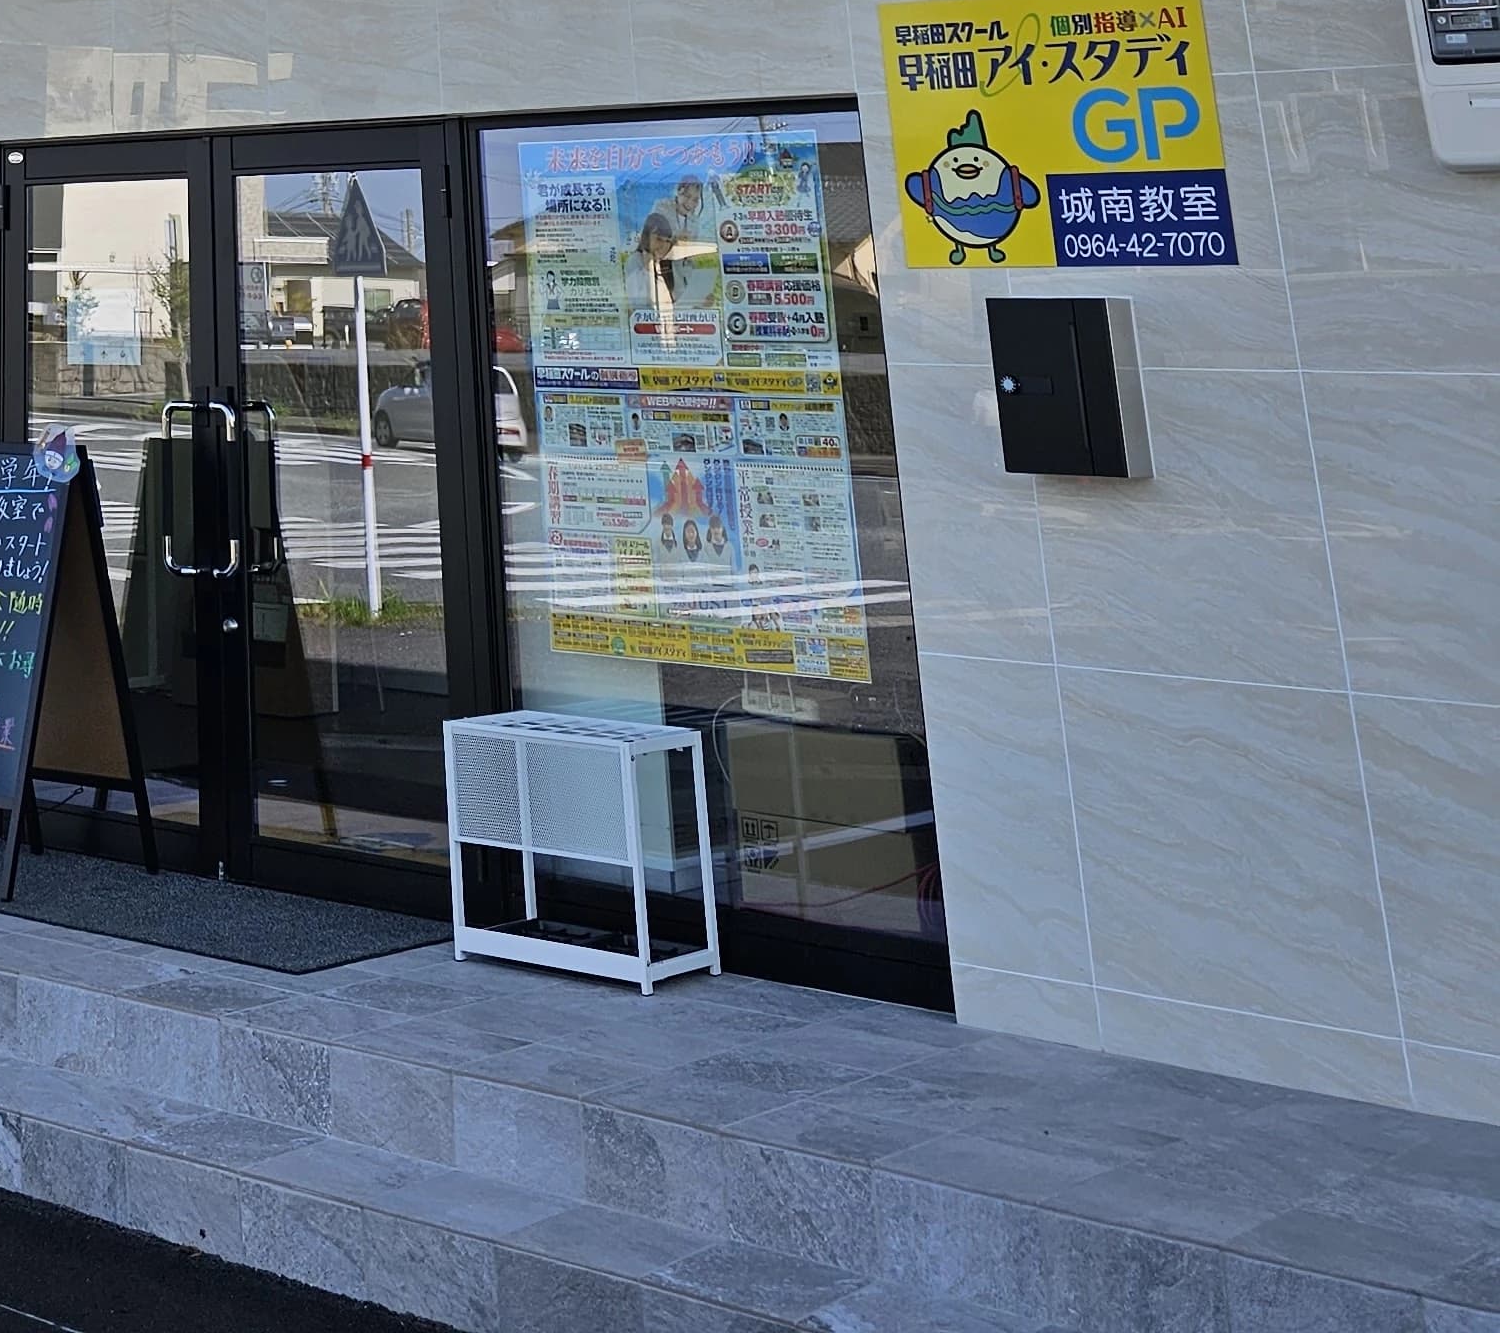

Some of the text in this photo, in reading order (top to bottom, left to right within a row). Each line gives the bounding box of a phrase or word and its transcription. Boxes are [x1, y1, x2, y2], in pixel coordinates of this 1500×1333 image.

[895, 20, 1009, 47] 早稲田スクール
[1050, 6, 1188, 37] 個別指導×AI
[898, 33, 1191, 92] 早稲田アイ・スタディ
[1072, 86, 1201, 164] GP
[538, 182, 606, 197] 君が成長する
[1059, 183, 1220, 224] 城南教室
[1063, 231, 1225, 259] 0964-42-7070
